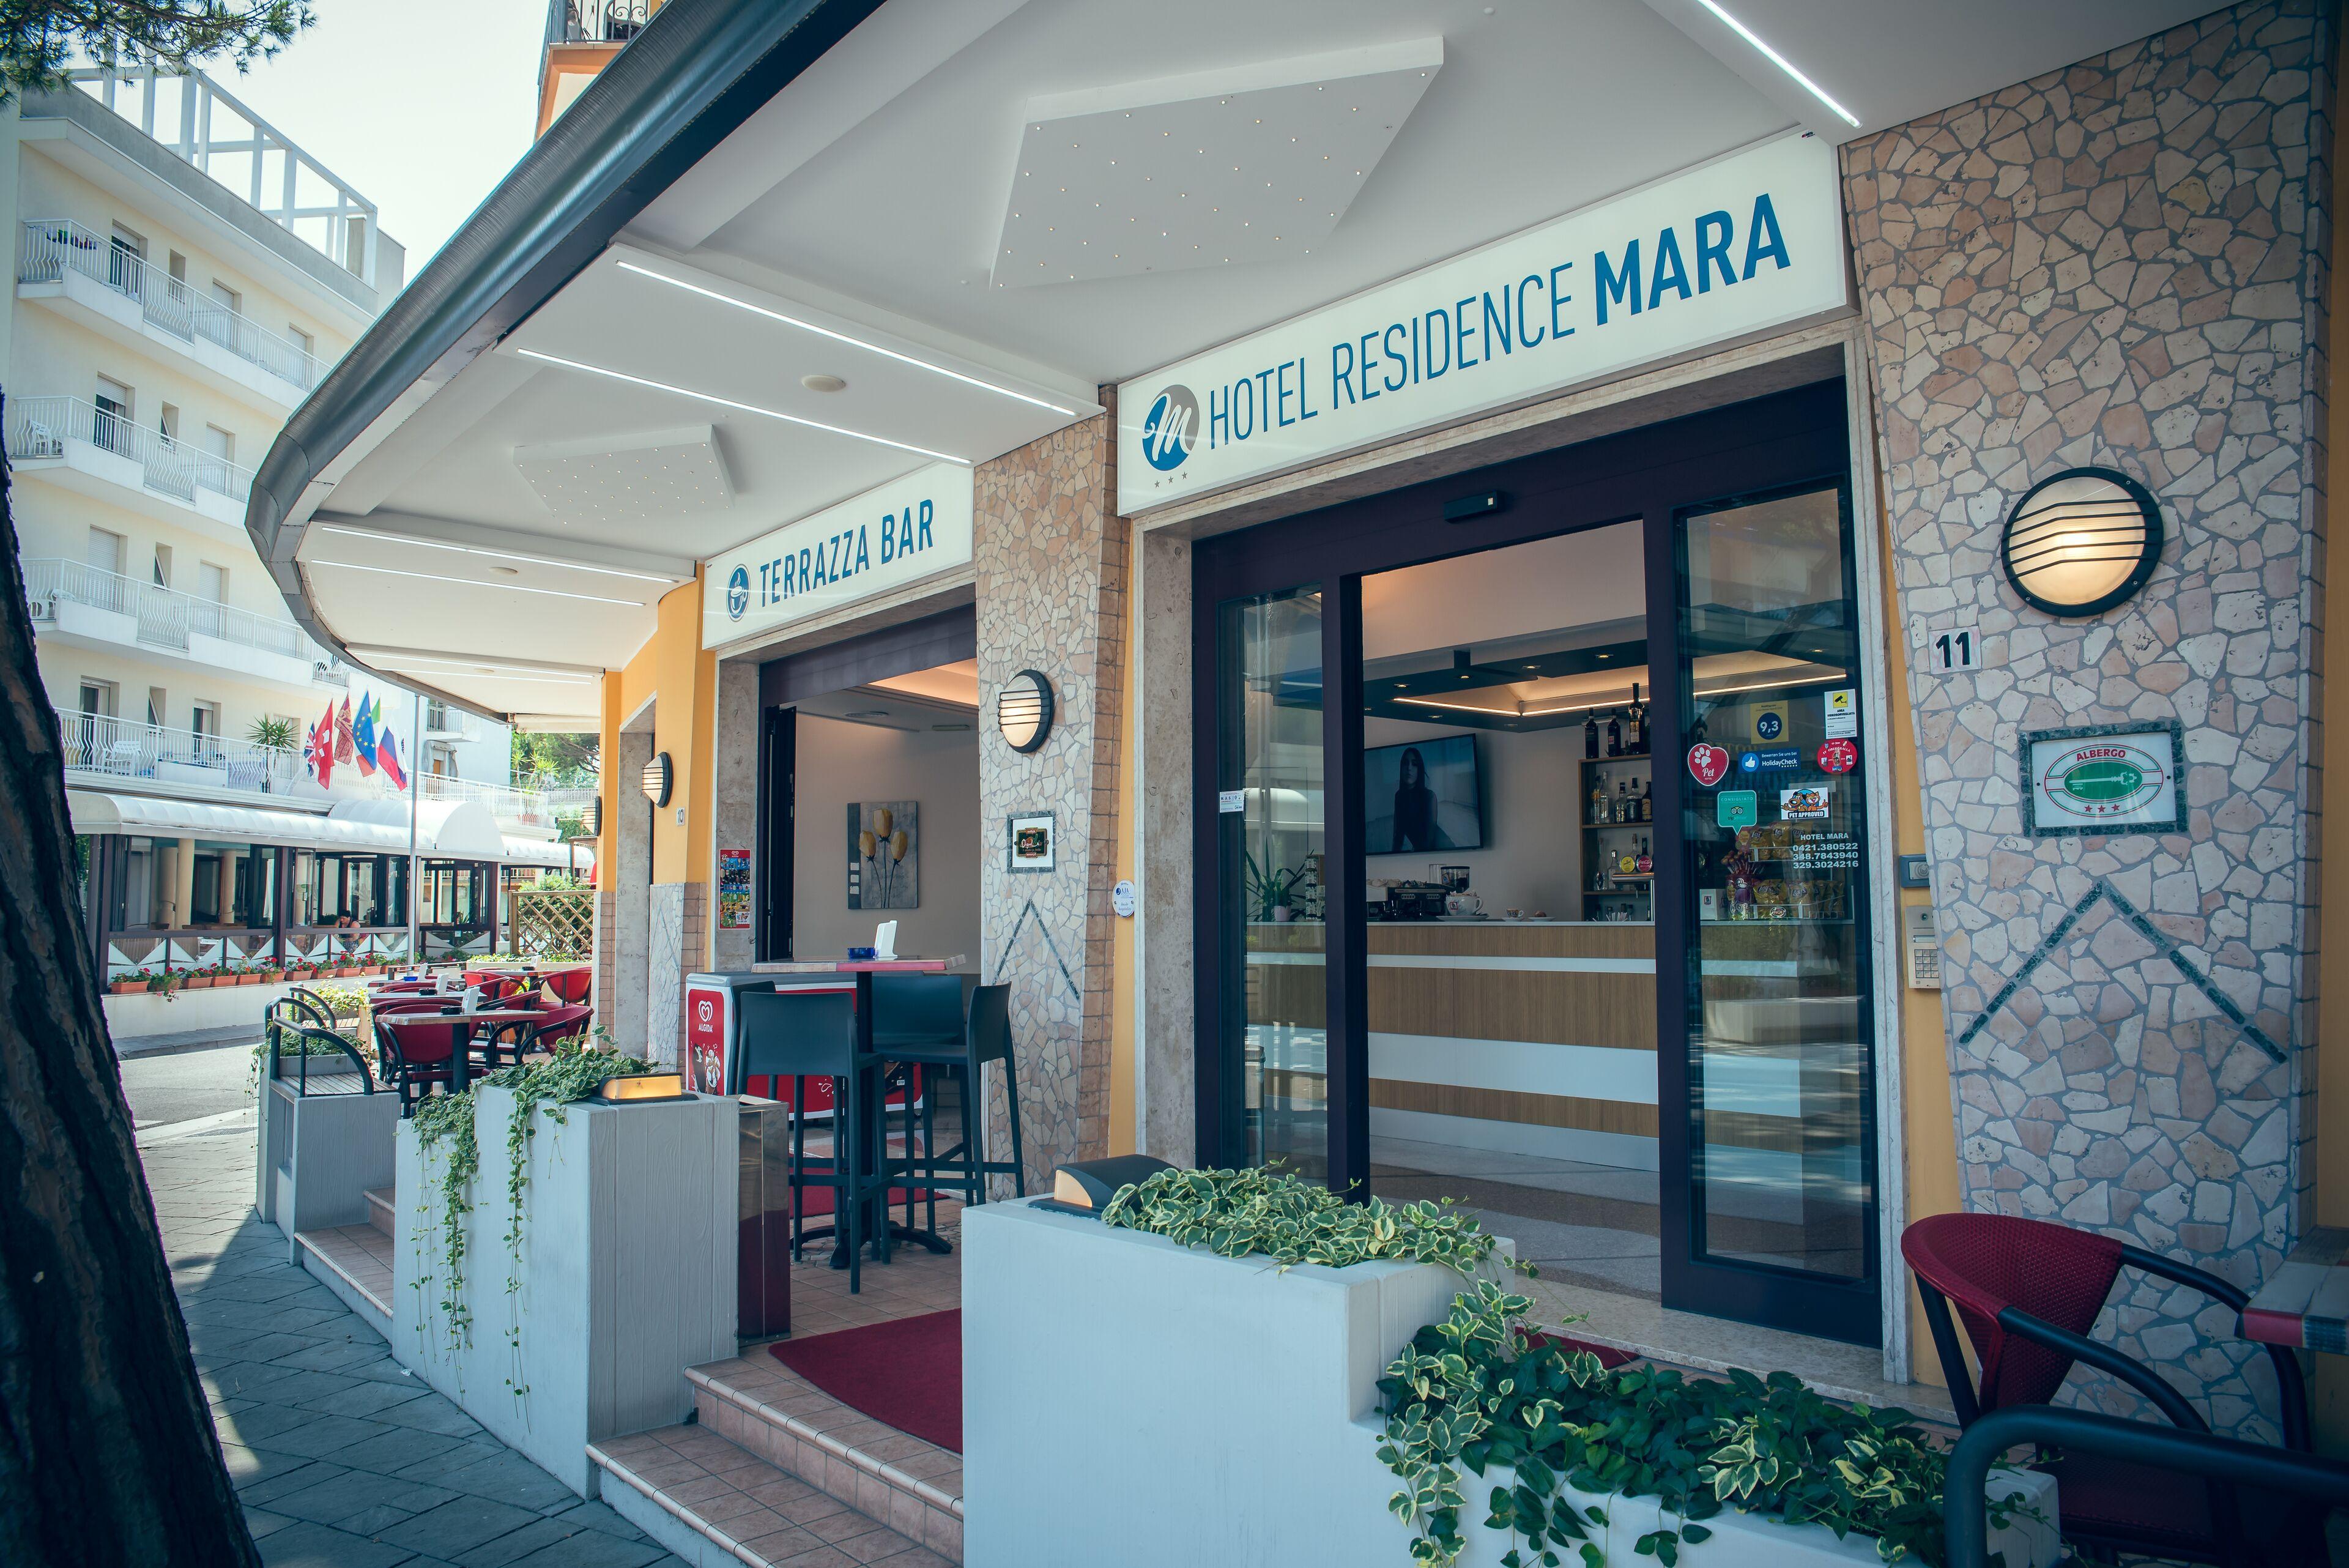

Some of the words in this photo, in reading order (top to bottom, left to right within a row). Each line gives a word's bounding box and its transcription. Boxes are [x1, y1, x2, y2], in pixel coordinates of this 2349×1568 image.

[1210, 357, 1318, 450] HOTEL
[1332, 262, 1576, 410] RESIDENCE
[1594, 193, 1792, 327] MARA
[760, 524, 870, 608] TERRAZZA
[881, 499, 934, 564] BAR
[1935, 631, 1971, 668] 11
[1760, 721, 1779, 733] 9,3
[2076, 748, 2126, 762] ALBERGO
[1762, 759, 1797, 767] HolidayCheck
[1702, 768, 1714, 777] Pet
[677, 809, 684, 823] 10
[1792, 842, 1858, 852] 0421.380522
[1792, 852, 1858, 861] 348.7843940
[1793, 860, 1859, 869] 329.3024216
[698, 1023, 713, 1033] ALGIDA
